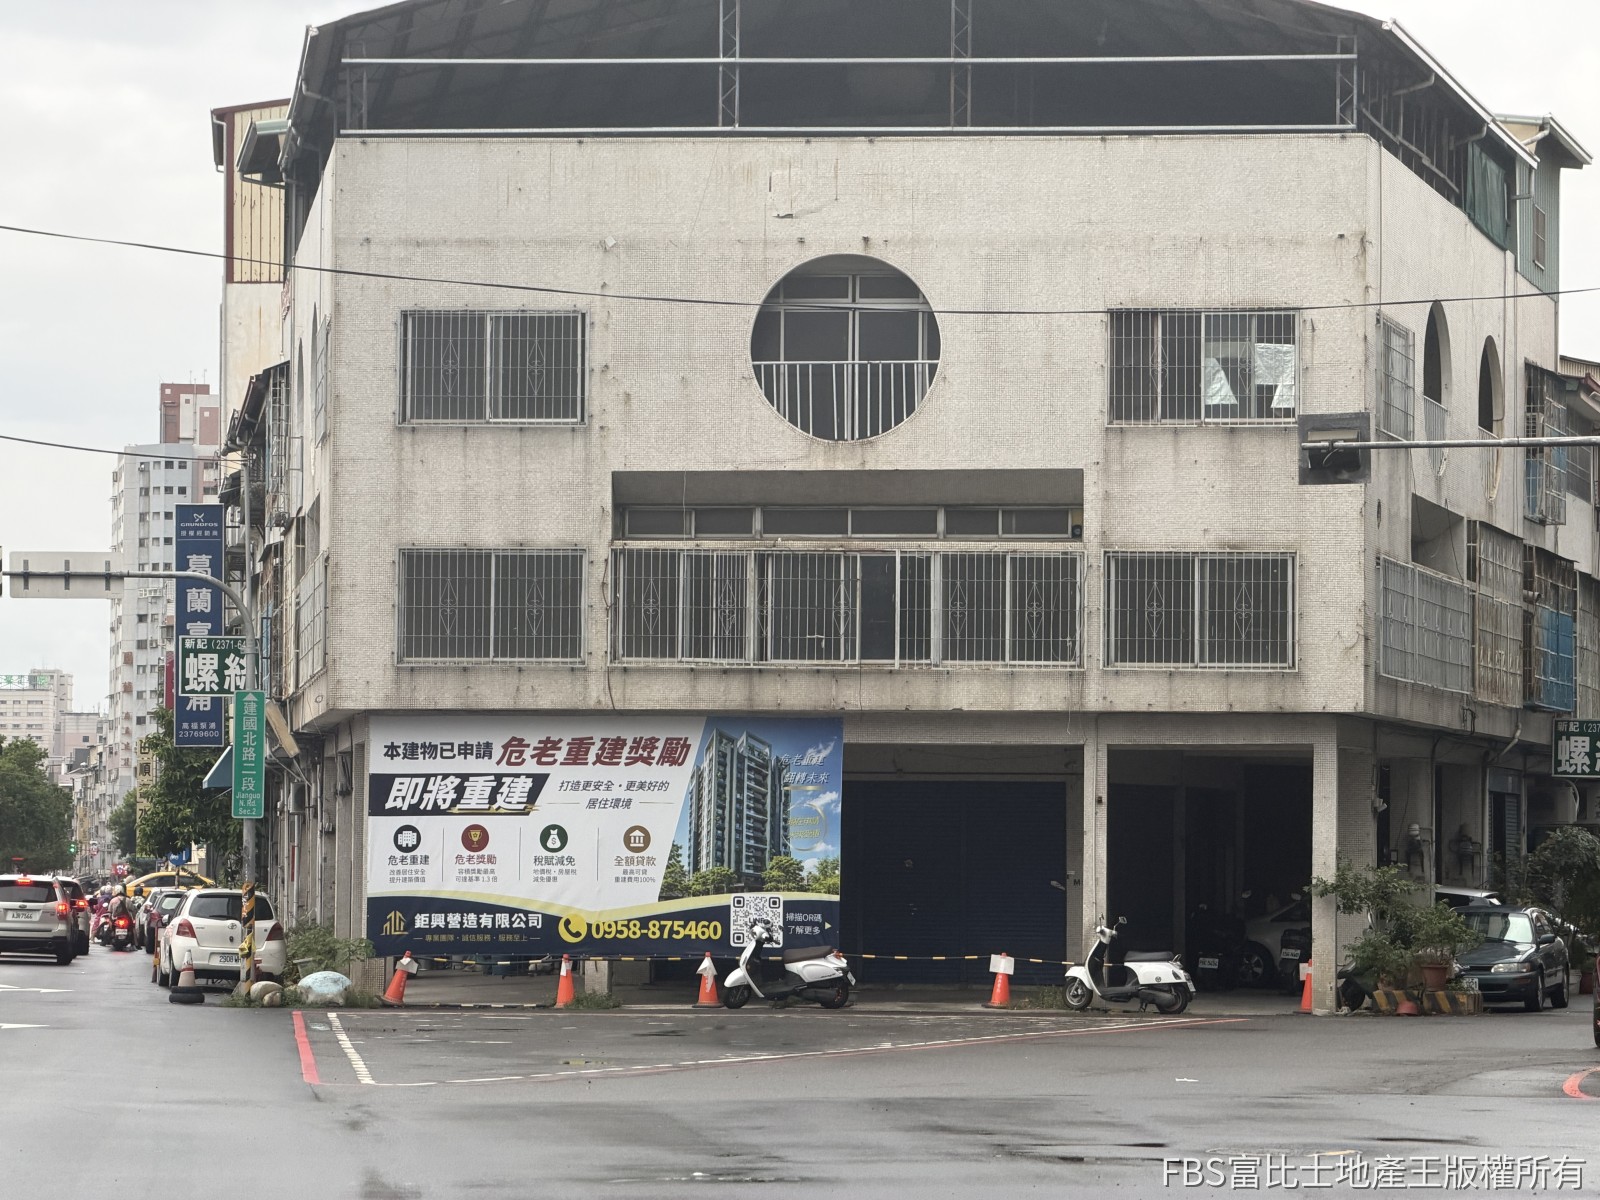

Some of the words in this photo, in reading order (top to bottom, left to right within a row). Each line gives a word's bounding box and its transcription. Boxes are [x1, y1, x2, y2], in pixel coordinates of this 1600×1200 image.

[184, 638, 208, 649] 新記
[241, 702, 258, 791] 建國北路二段
[383, 741, 493, 760] 本建物已申請
[495, 735, 692, 767] 危老重建獎勵
[1557, 735, 1600, 774] 螺
[236, 792, 260, 800] Jianguo
[384, 775, 533, 811] 即將重建
[585, 797, 633, 810] 居住環境
[387, 854, 430, 866] 危老重建
[454, 854, 497, 865] 危老獎勵
[614, 856, 656, 867] 全額貸款
[414, 912, 543, 929] 鉅興營造有限公司
[591, 920, 722, 940] 0958-875460
[787, 925, 821, 935] 了解更多
